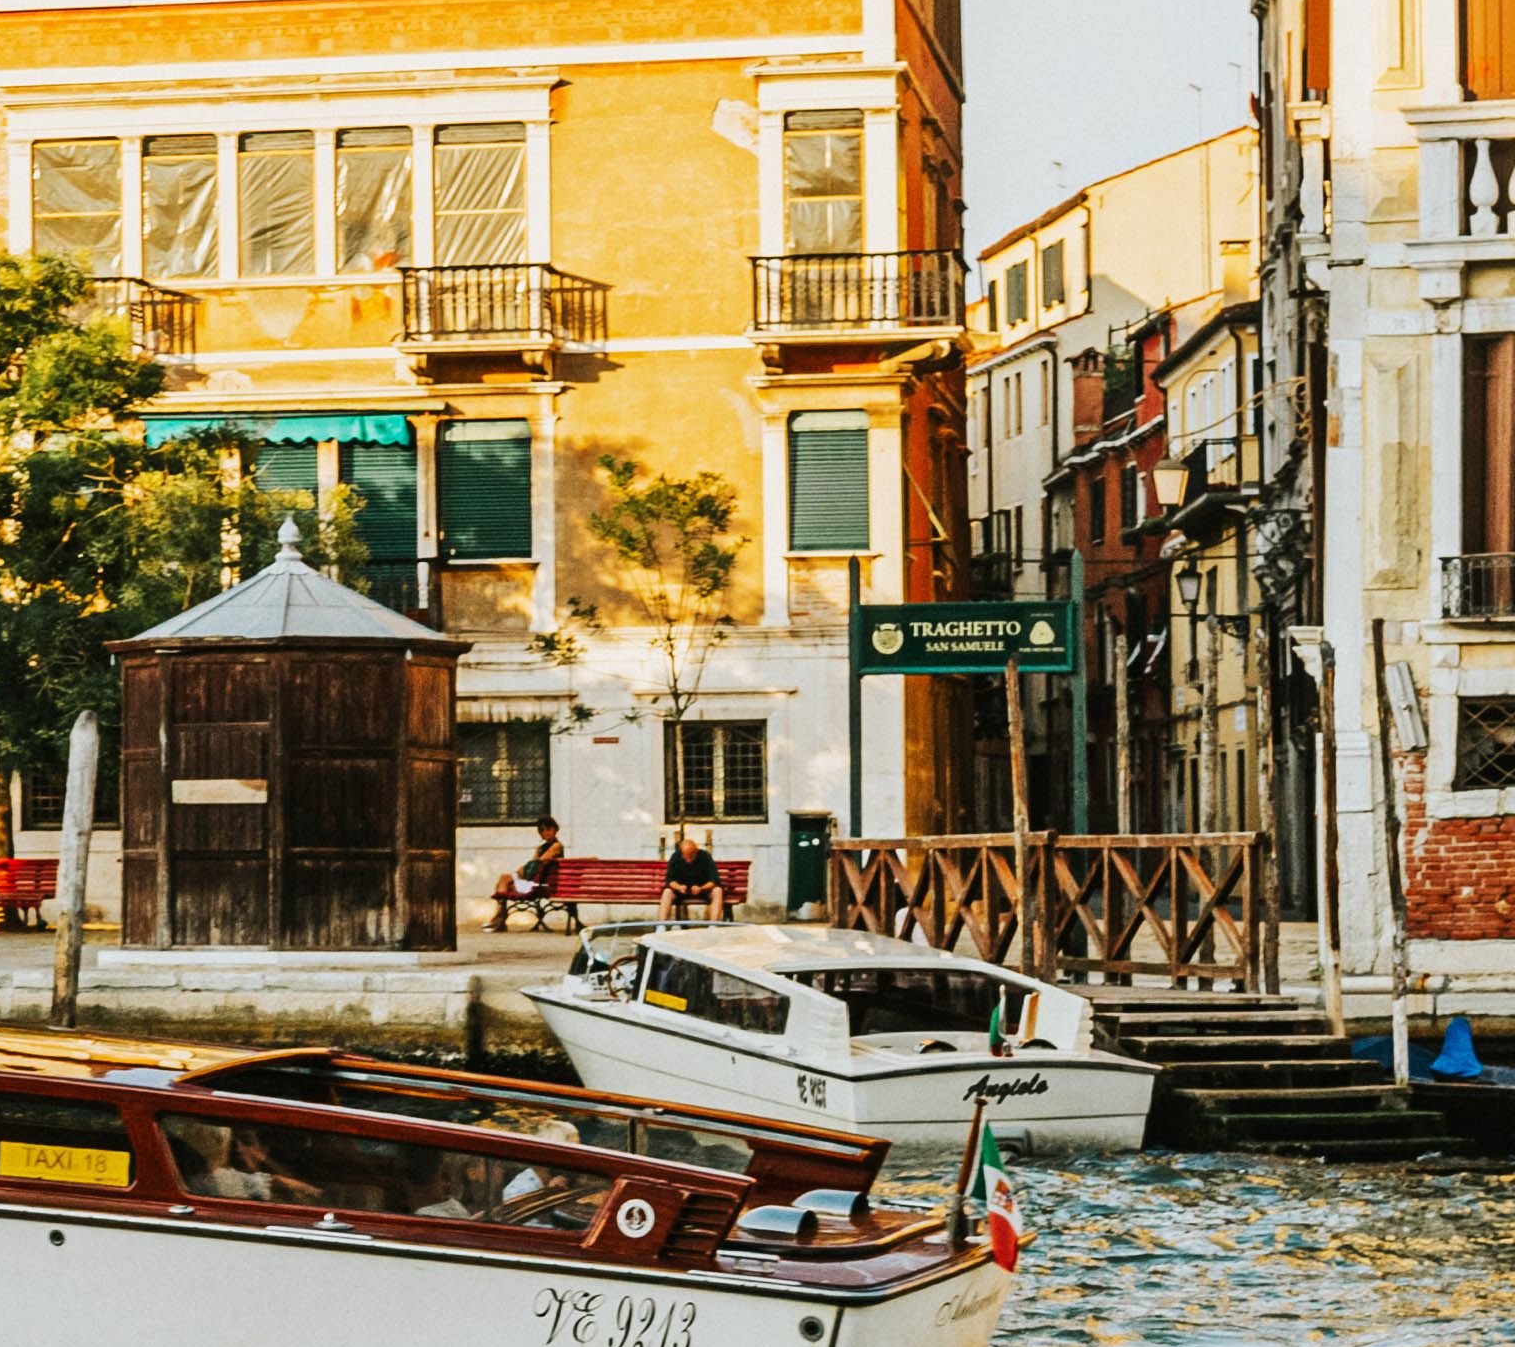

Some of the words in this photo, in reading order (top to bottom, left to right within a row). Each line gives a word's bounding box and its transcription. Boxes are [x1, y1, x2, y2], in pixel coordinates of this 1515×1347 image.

[909, 620, 1021, 637] TRAGHETTO
[925, 641, 949, 652] SAN
[950, 640, 1006, 652] SAMUELE
[21, 1147, 73, 1170] TAXI
[83, 1154, 108, 1174] 18
[533, 1288, 606, 1346] VE
